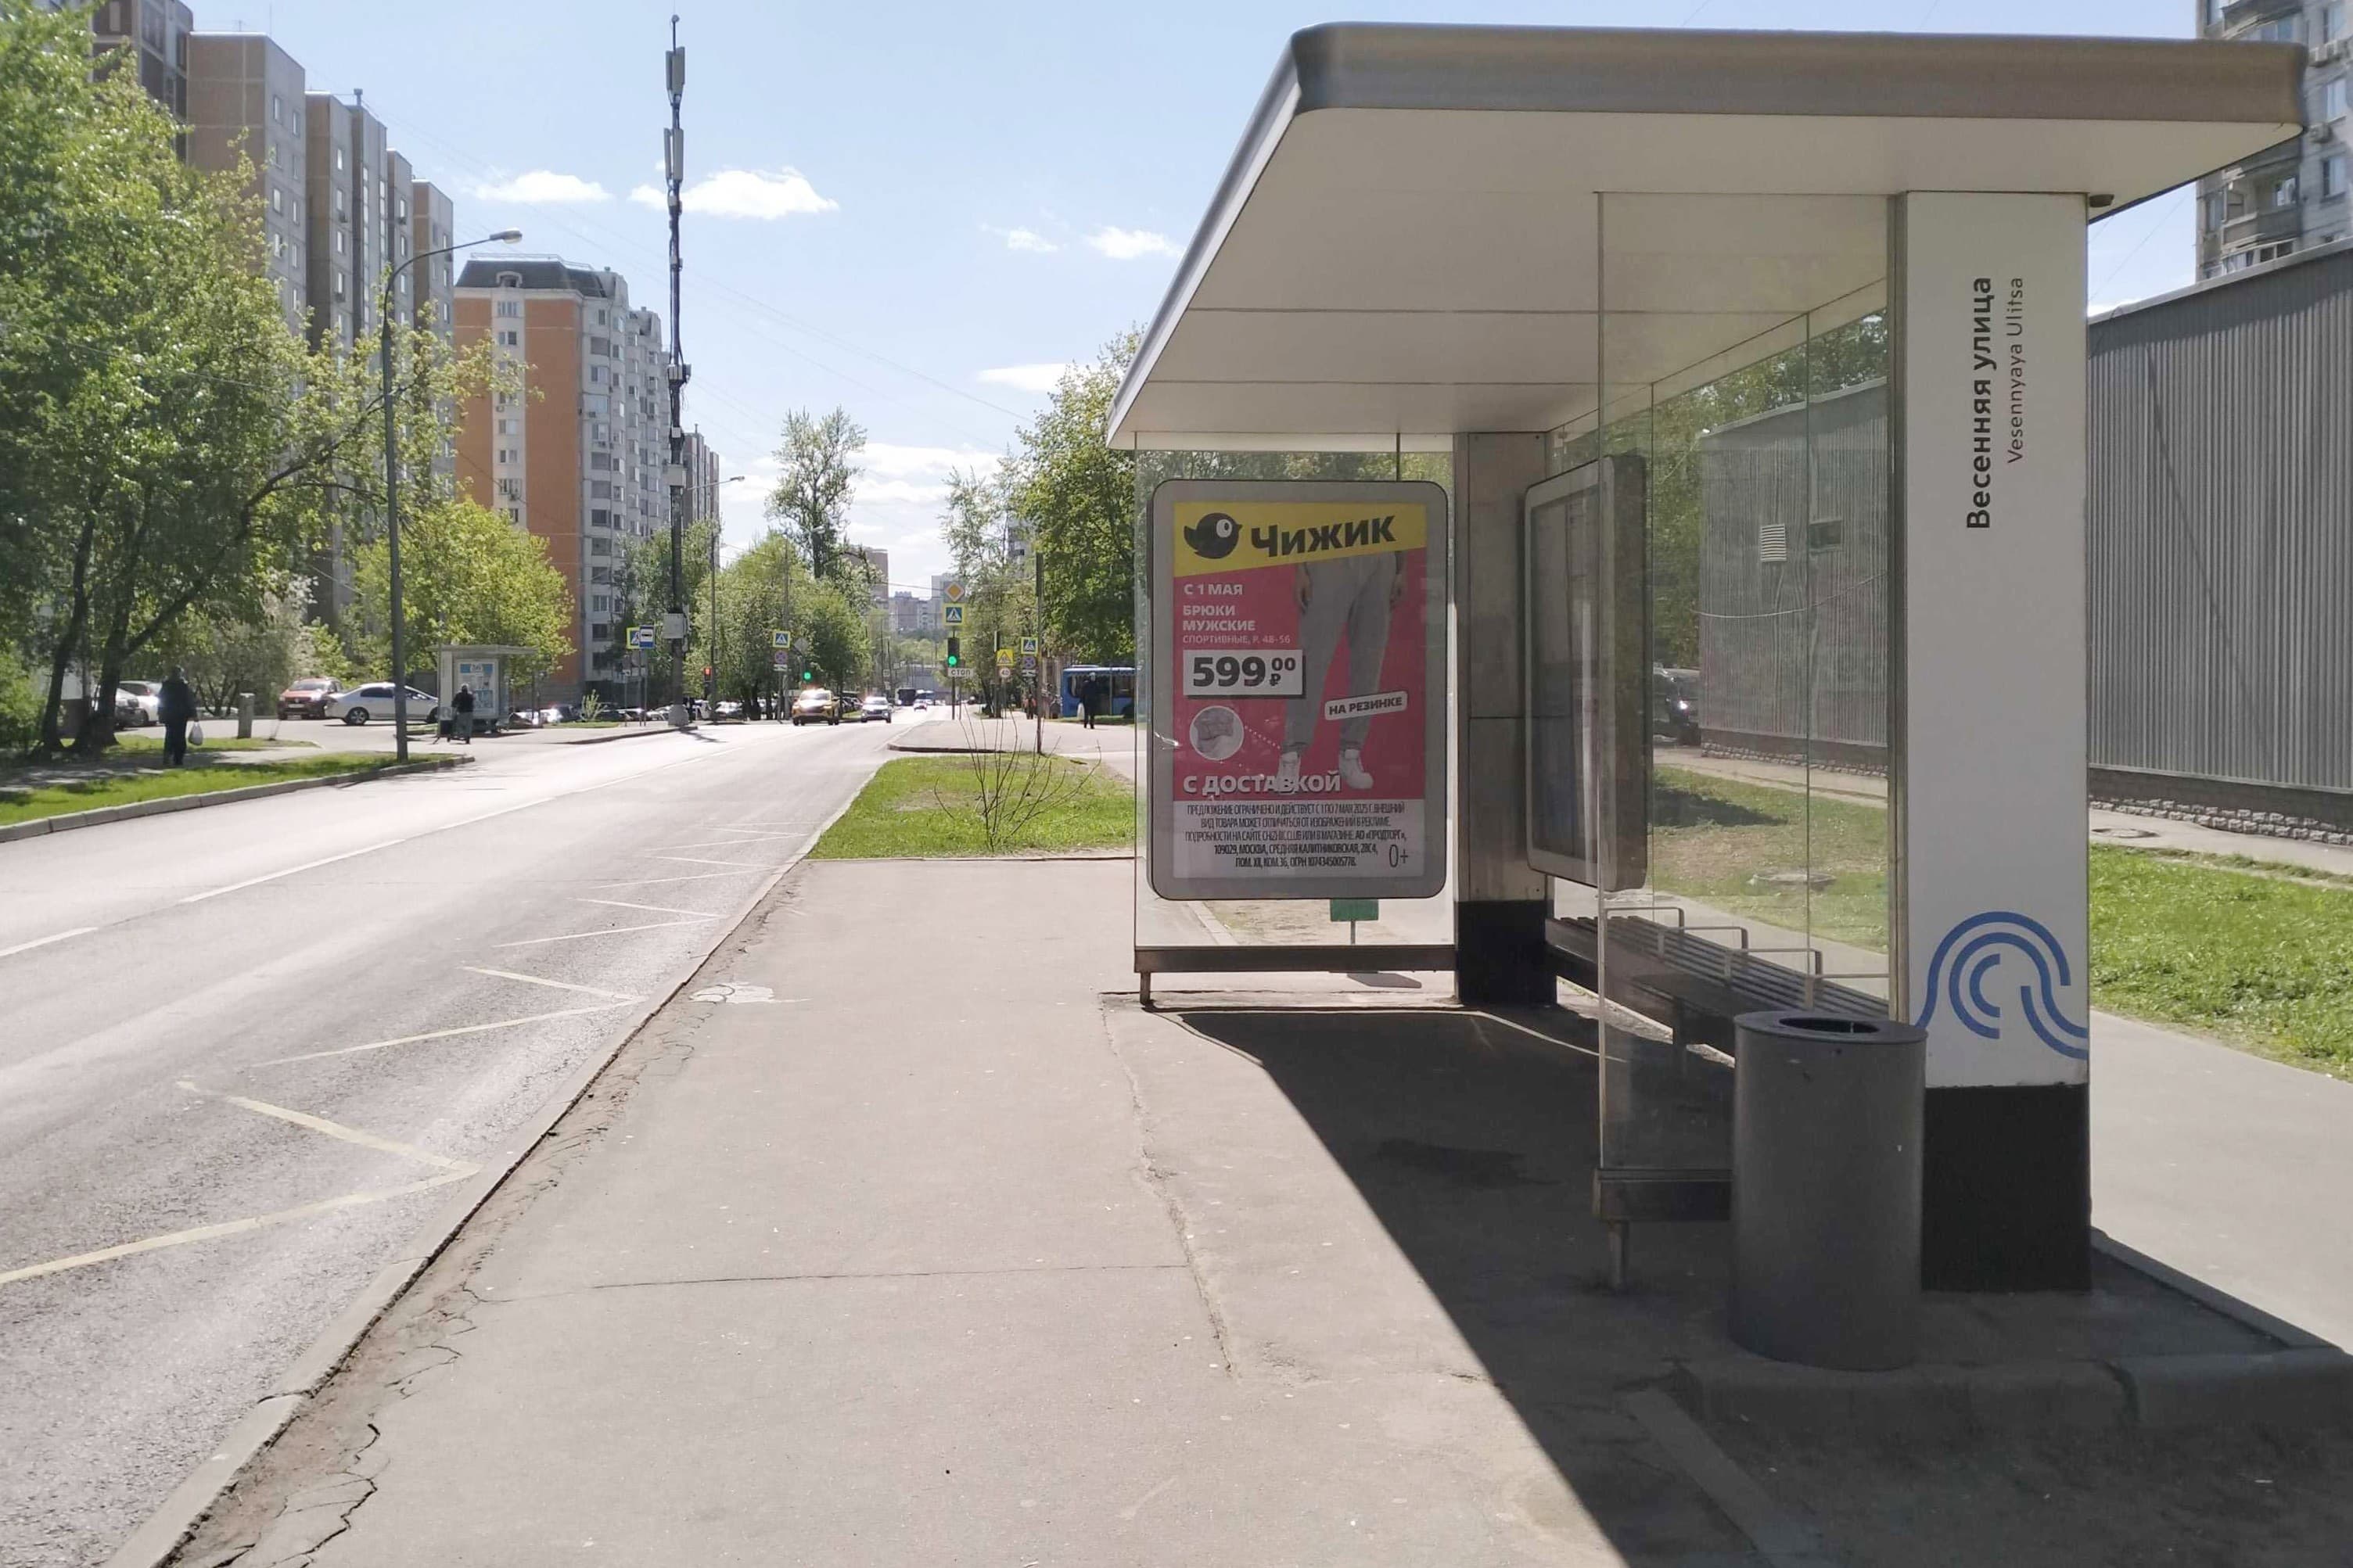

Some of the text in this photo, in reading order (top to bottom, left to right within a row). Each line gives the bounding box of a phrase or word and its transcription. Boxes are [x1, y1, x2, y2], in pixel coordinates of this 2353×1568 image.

[2006, 278, 2027, 464] Vesennyaya Ulitsa
[1966, 277, 1997, 529] Весенняя улица
[1184, 583, 1244, 595] С 1 МАЯ
[1183, 605, 1236, 616] БРЮКИ
[1183, 619, 1256, 631] МУЖСКИЕ
[1183, 634, 1251, 645] СПОРТИВНЫЕ,
[1193, 657, 1266, 687] 599
[1271, 657, 1296, 671] 00
[1328, 696, 1403, 716] НА РЕЗИНКЕ
[1183, 770, 1342, 795] С ДОСТАВКОЙ
[1187, 805, 1234, 816] ПРЕДЛОЖЕНИЕ
[1388, 844, 1409, 868] 0+
